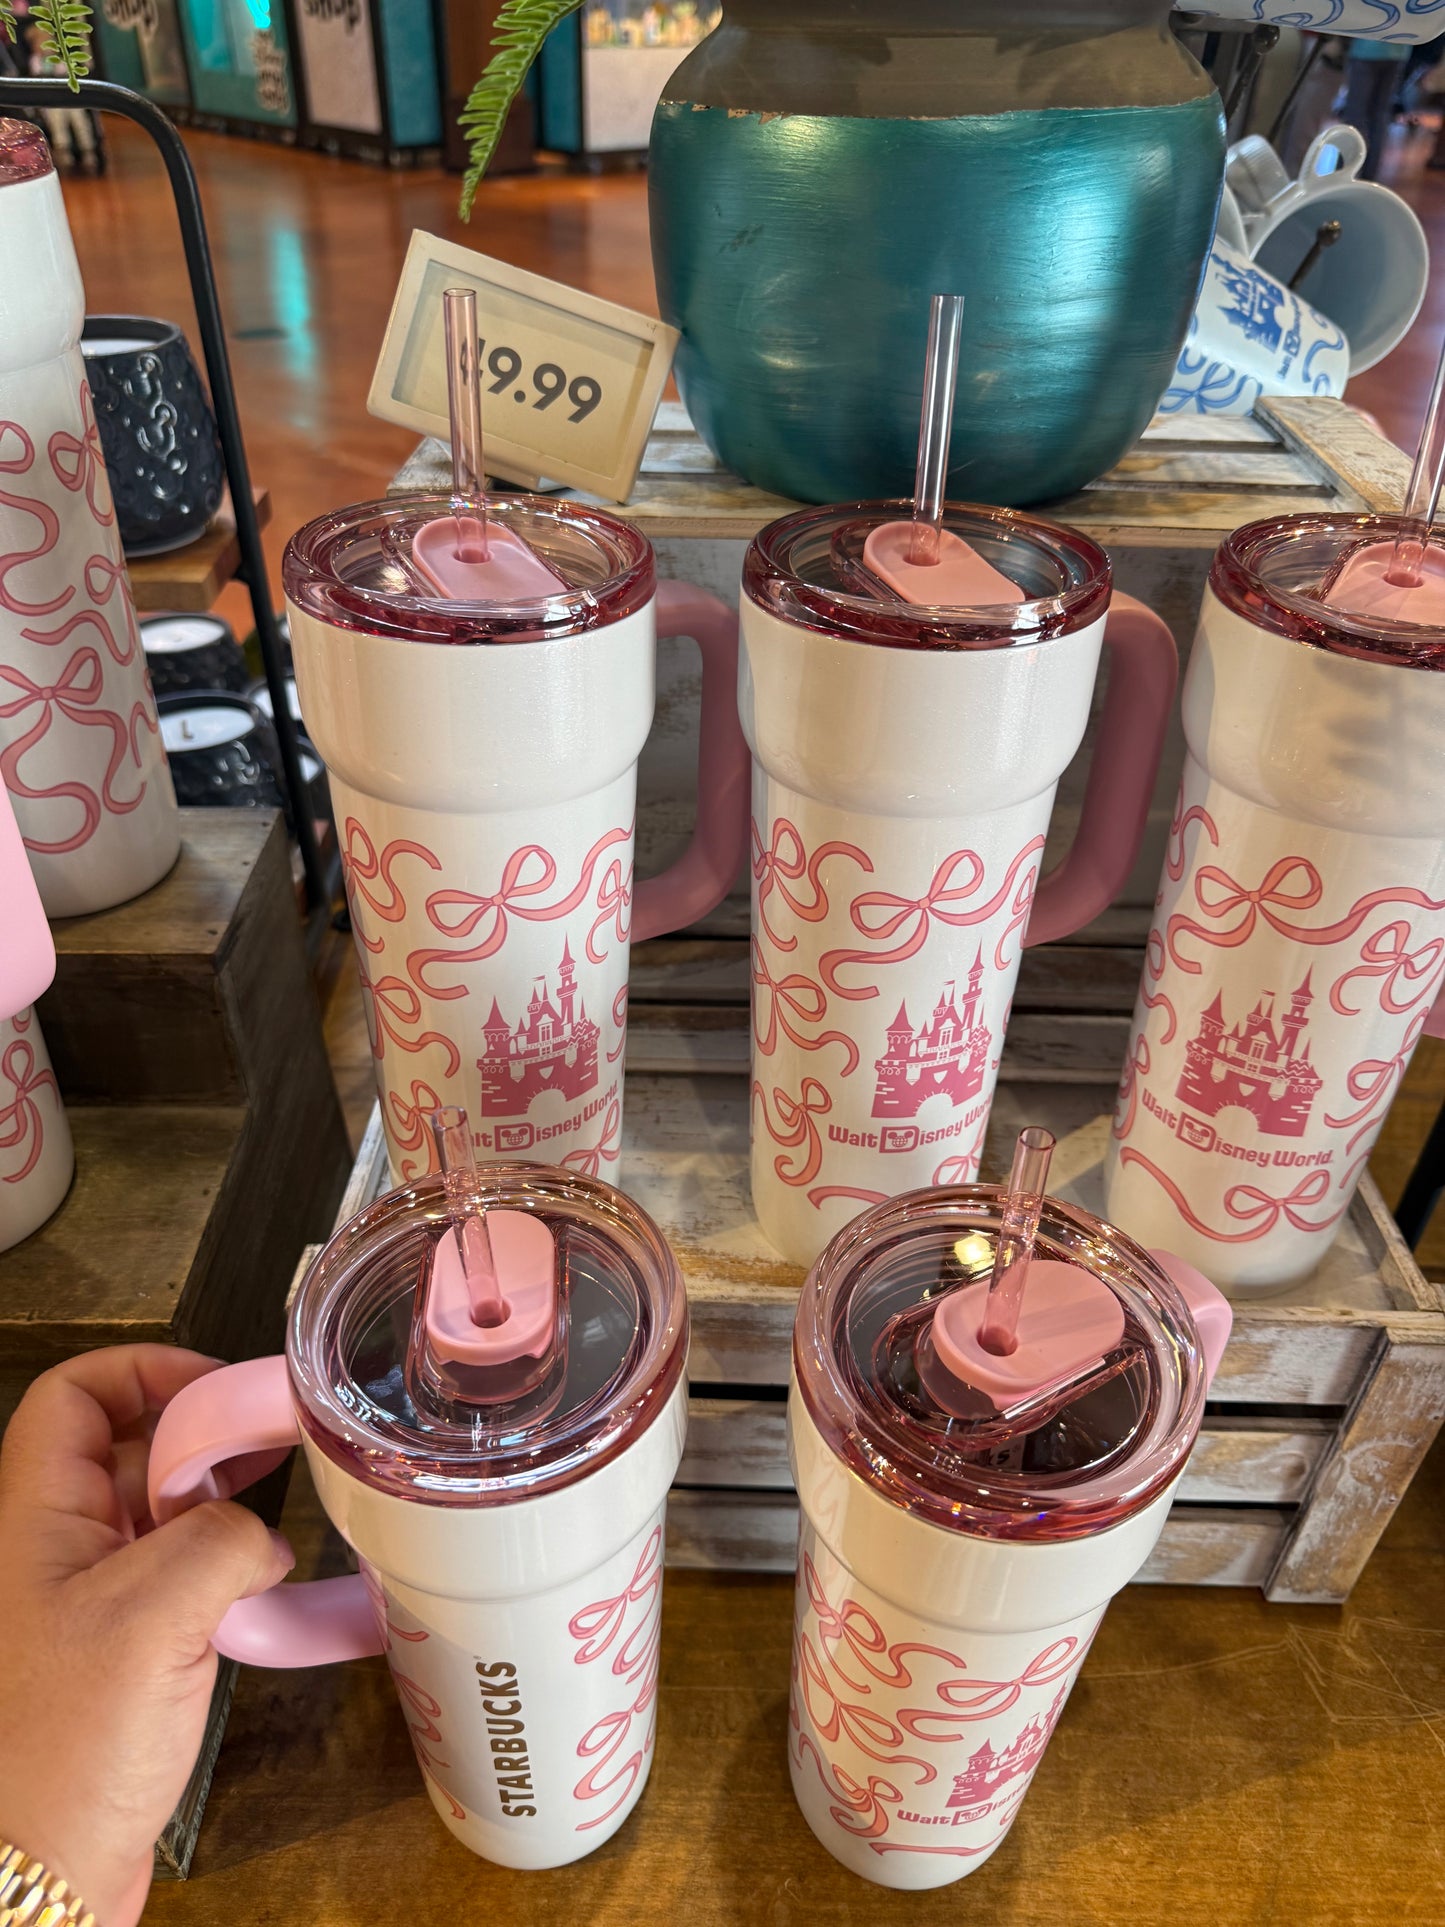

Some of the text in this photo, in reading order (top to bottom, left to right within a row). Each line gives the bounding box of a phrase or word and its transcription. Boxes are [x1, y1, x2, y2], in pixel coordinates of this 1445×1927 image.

[494, 1113, 583, 1153] Disney
[583, 1079, 619, 1122] World
[828, 1124, 878, 1149] Walt
[879, 1119, 964, 1154] Disney
[1141, 1087, 1334, 1168] Walt Disney World
[475, 1661, 537, 1817] STARBUCKS
[896, 1809, 952, 1825] Walt
